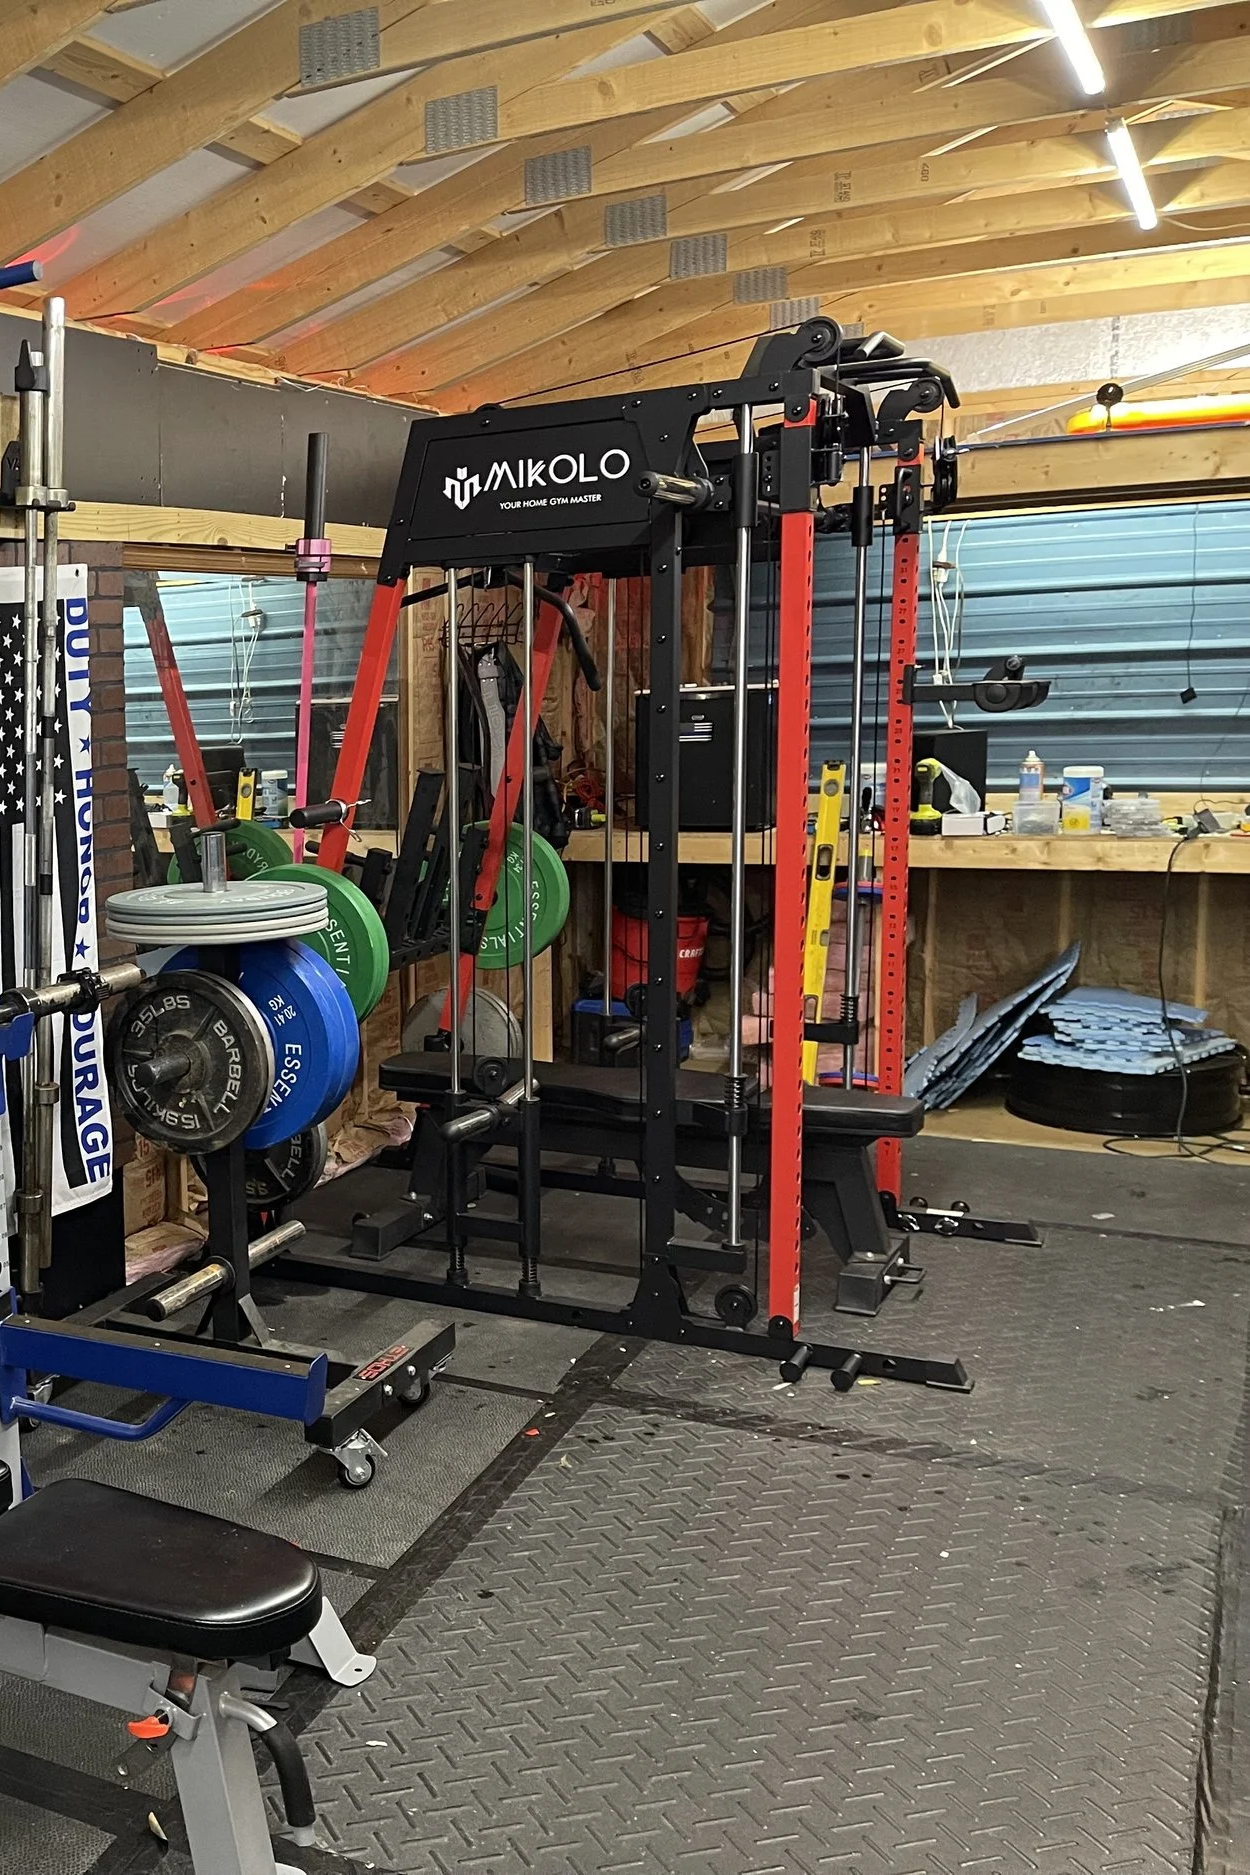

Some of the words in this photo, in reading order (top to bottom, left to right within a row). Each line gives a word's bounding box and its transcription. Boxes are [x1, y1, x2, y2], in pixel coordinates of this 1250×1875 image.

[483, 448, 630, 492] MIKOLO
[500, 501, 522, 510] YOUR
[523, 498, 548, 508] HOME
[550, 497, 569, 506] GYM
[570, 493, 602, 504] MASTER
[131, 995, 191, 1038] 35LBS
[268, 994, 286, 1012] KG
[212, 1019, 242, 1114] BARBELL
